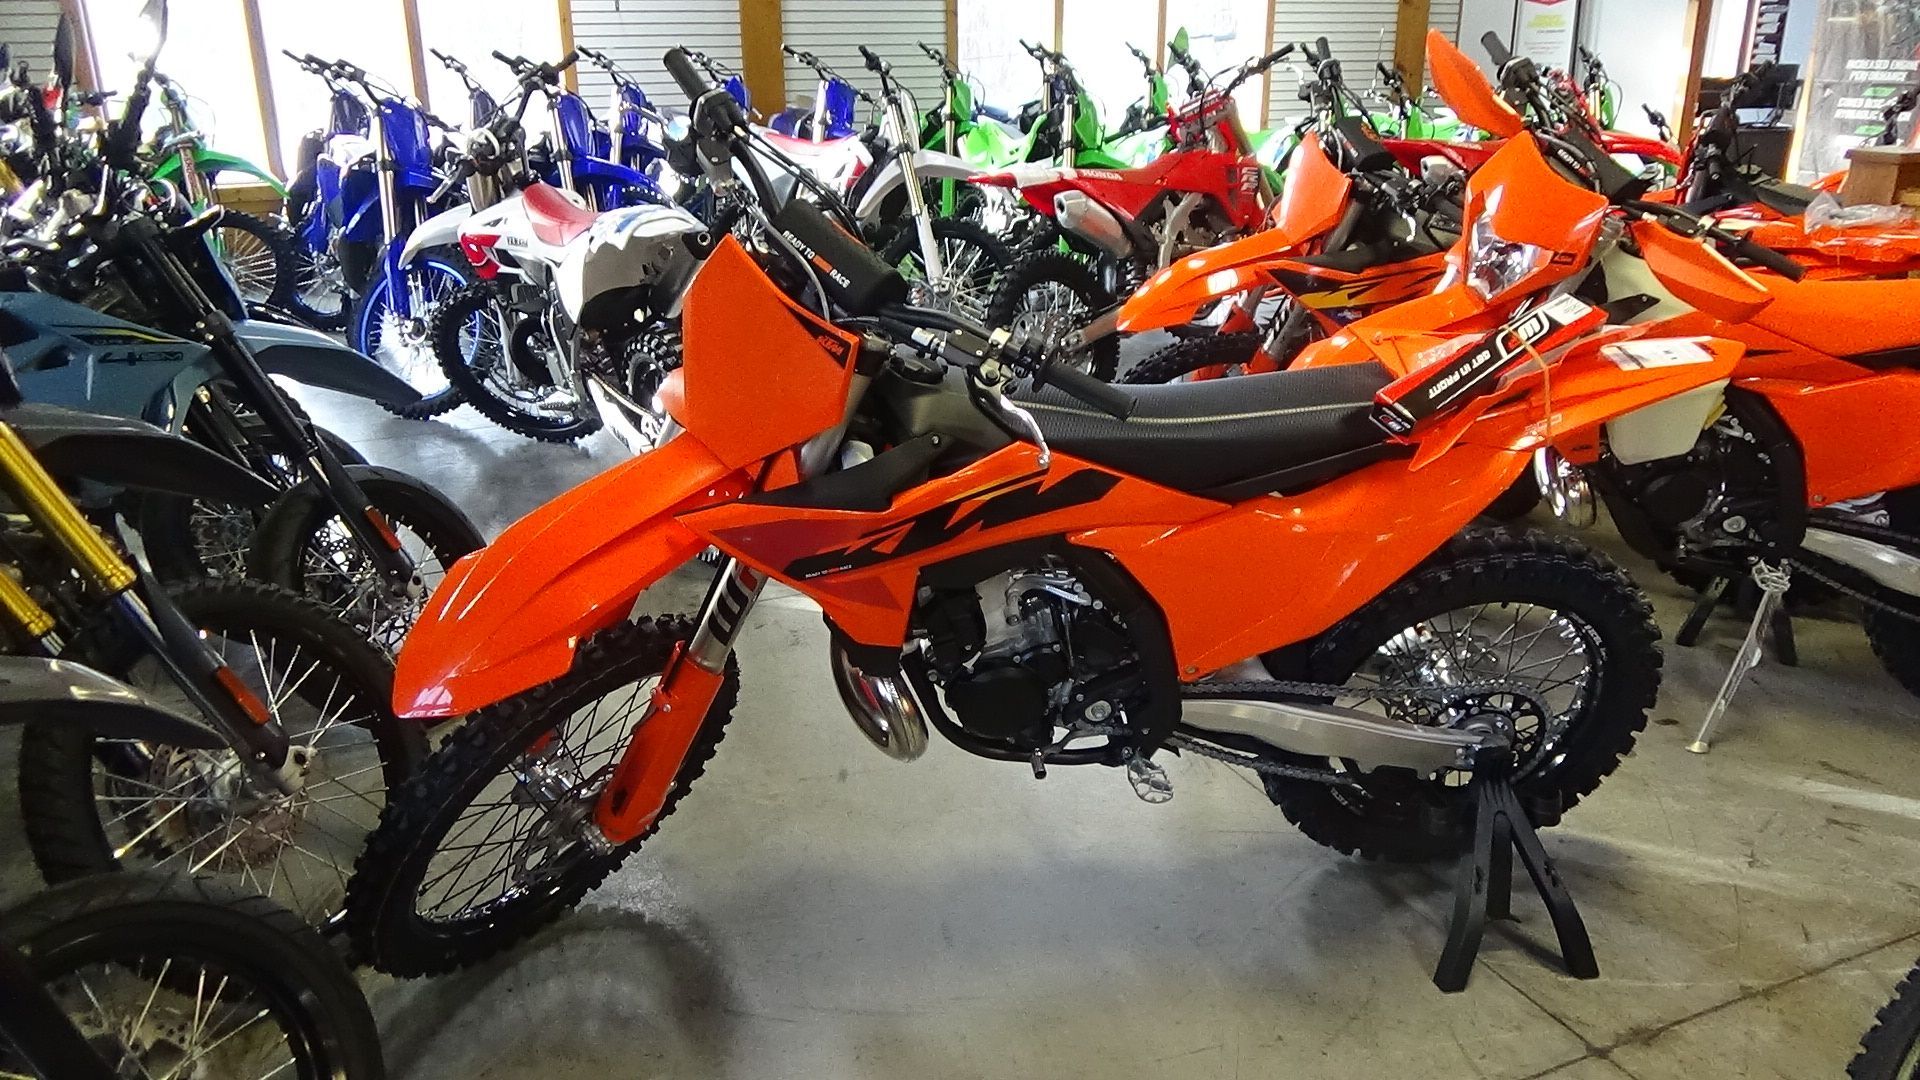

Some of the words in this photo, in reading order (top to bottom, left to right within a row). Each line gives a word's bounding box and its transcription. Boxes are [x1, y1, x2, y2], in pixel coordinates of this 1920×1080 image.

[1083, 169, 1124, 181] HONDA
[781, 229, 808, 251] READY
[803, 247, 816, 260] TO
[829, 268, 851, 289] RACE
[1458, 361, 1473, 377] IN
[1471, 349, 1491, 370] GET
[1428, 370, 1460, 400] FRONT
